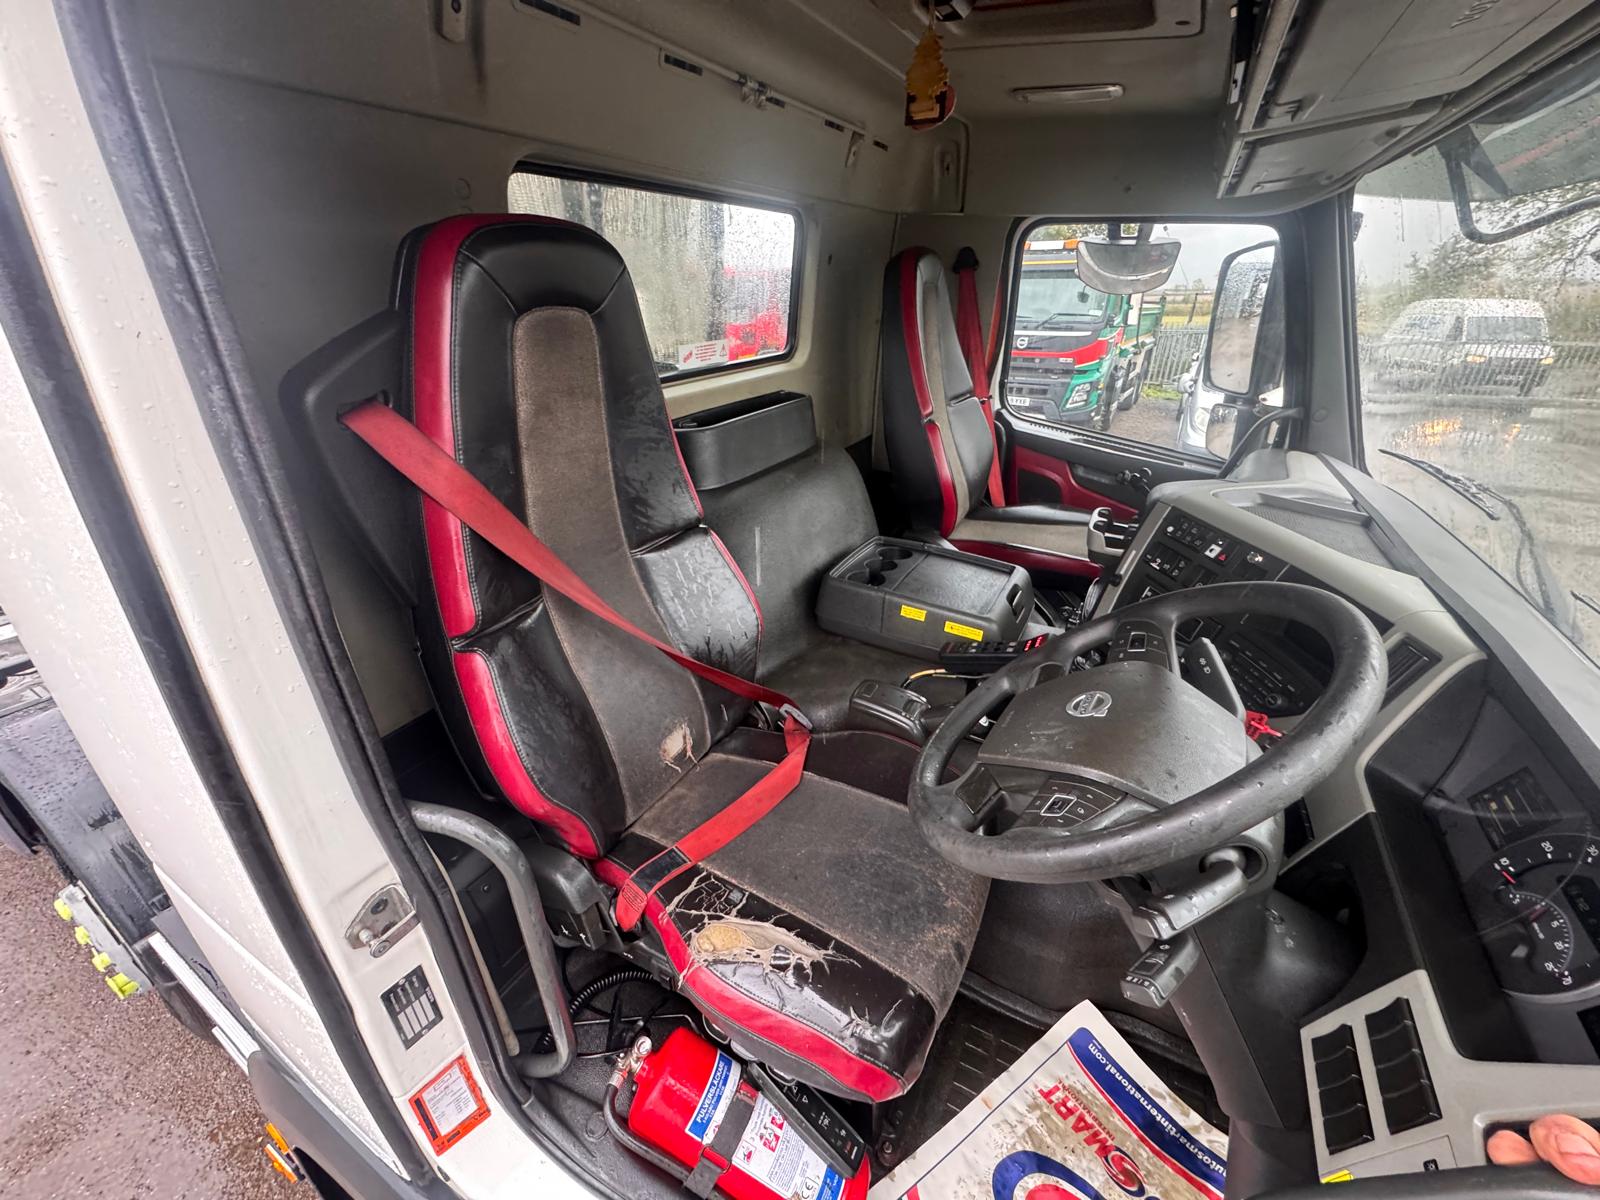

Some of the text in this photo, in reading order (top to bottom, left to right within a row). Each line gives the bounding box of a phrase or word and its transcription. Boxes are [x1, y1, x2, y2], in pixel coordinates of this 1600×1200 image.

[1541, 840, 1554, 852] 20
[1586, 845, 1599, 857] 30
[1500, 857, 1510, 866] 10
[1057, 1079, 1117, 1142] INTERNATIONAL
